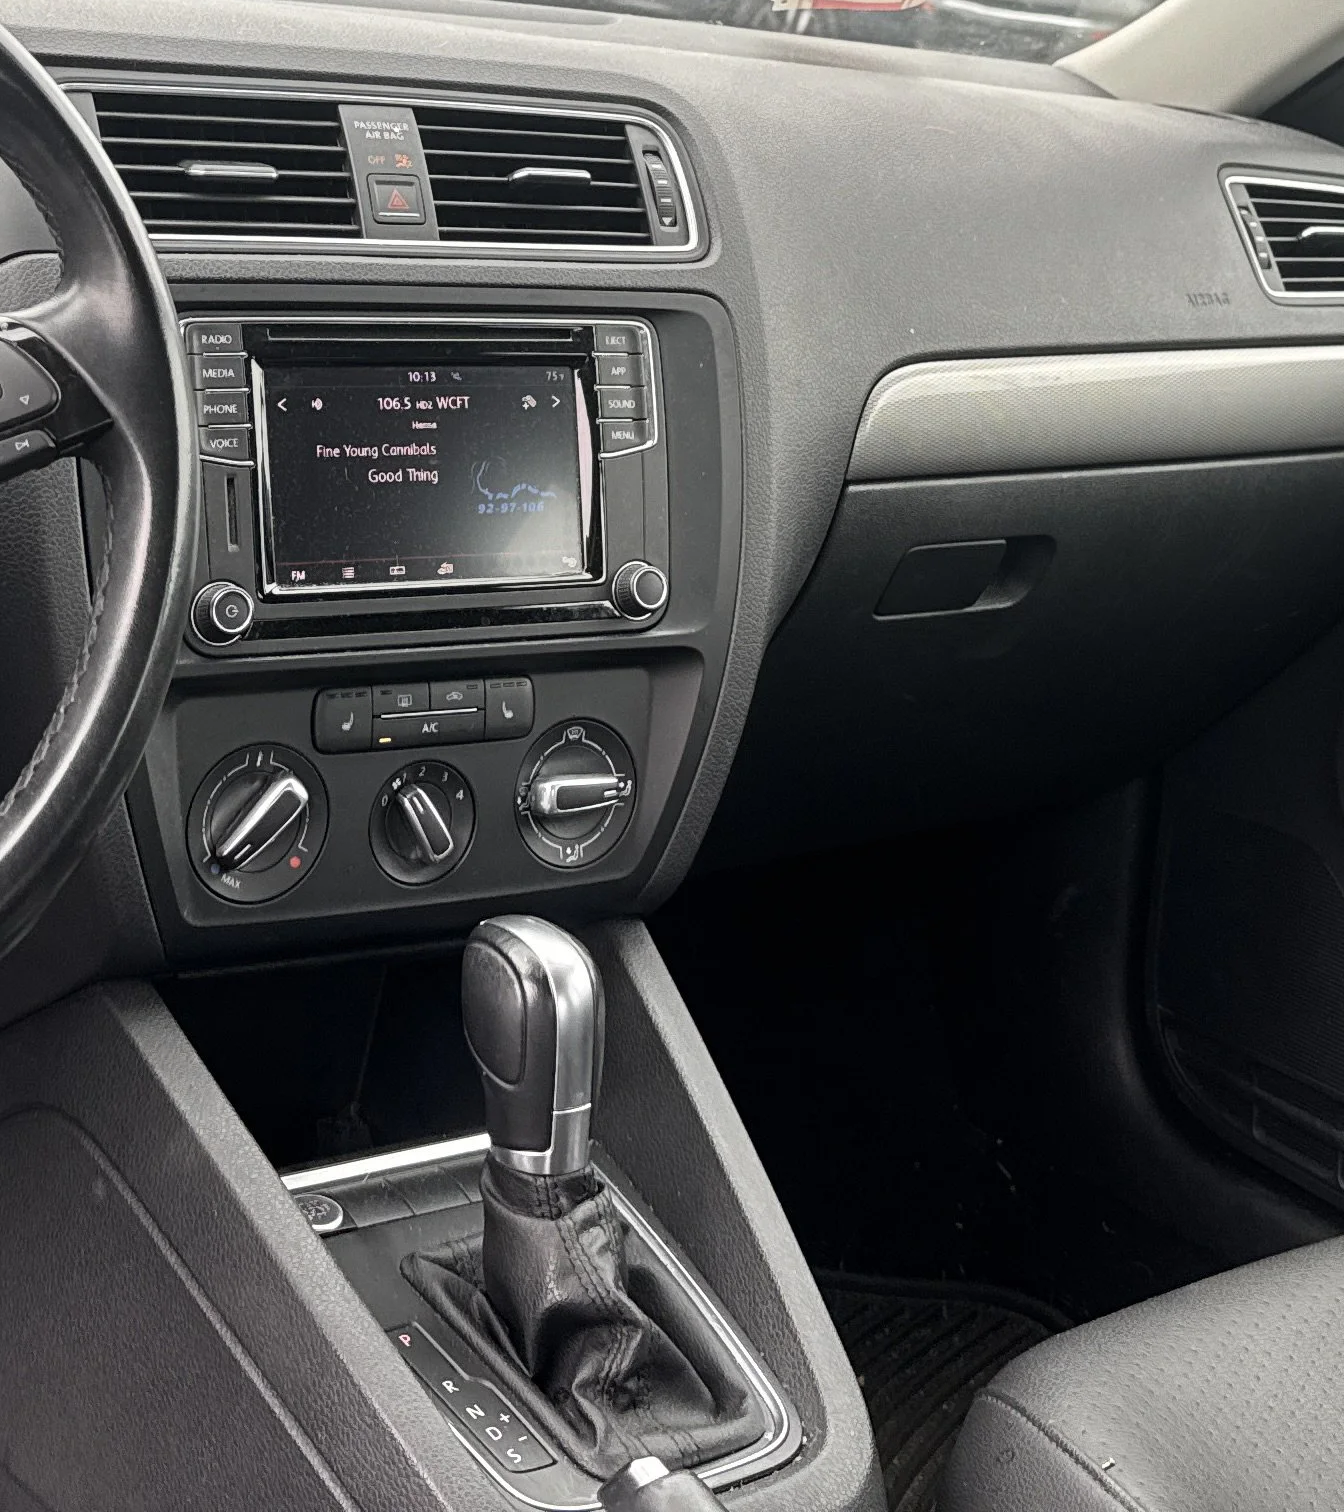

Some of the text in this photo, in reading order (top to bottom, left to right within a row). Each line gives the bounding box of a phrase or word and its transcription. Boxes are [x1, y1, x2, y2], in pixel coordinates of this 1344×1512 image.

[353, 120, 409, 131] PASSENGER
[366, 130, 405, 141] AIR BAG
[201, 334, 233, 345] RADIO
[605, 335, 626, 345] EJECT
[202, 368, 235, 378] MEDIA
[407, 371, 436, 382] 10:13
[610, 366, 627, 376] APP
[203, 404, 238, 414] PHONE
[376, 395, 471, 411] 106.5 HD2 WCFT
[608, 399, 636, 409] SOUND
[611, 430, 635, 440] MENU
[209, 437, 239, 449] VOICE
[316, 442, 437, 460] Fine Young Cannibals
[368, 467, 439, 484] Good Thing
[291, 570, 306, 582] FM
[421, 721, 439, 734] A/C
[418, 765, 426, 778] 2
[441, 771, 449, 782] 3
[381, 794, 389, 807] 0
[455, 788, 465, 801] 4
[220, 871, 242, 889] MAX
[398, 1334, 411, 1347] P
[442, 1380, 460, 1394] R
[465, 1403, 486, 1420] N
[485, 1426, 503, 1441] D
[506, 1448, 522, 1464] S
